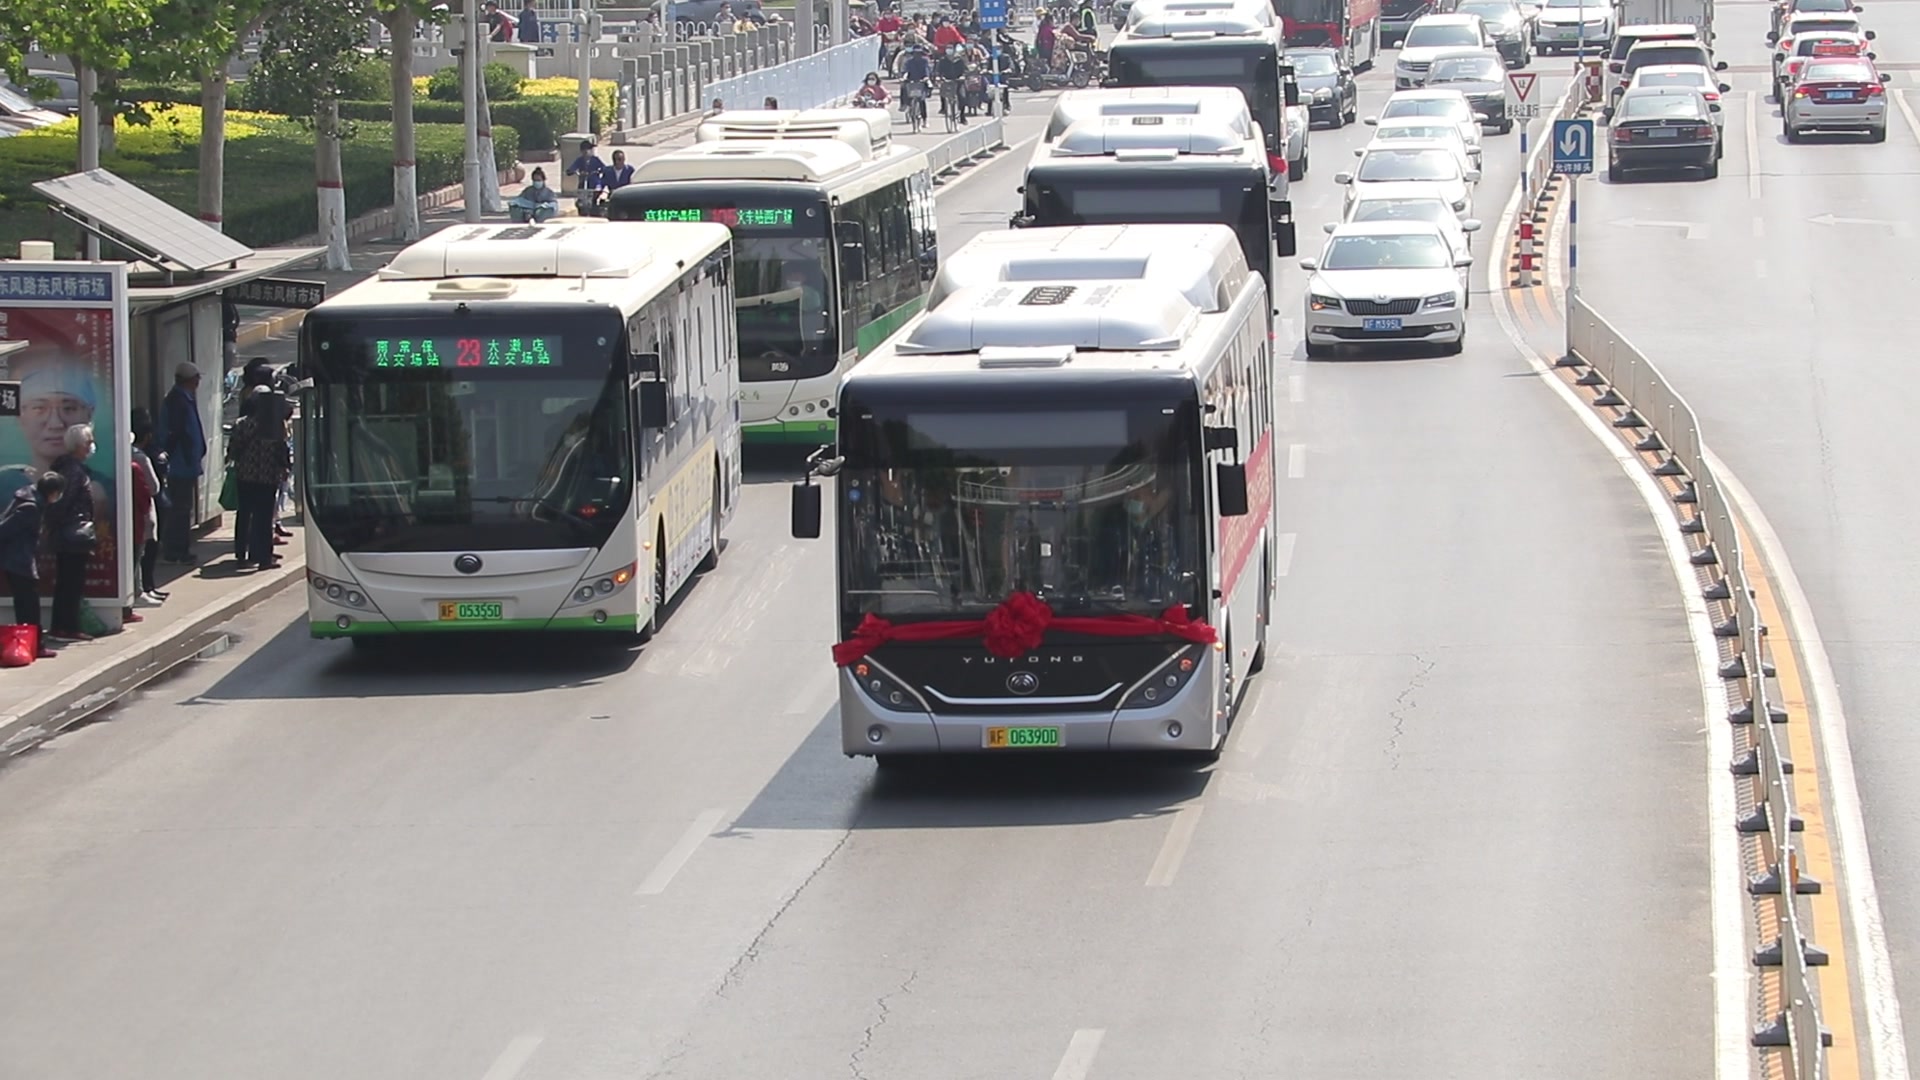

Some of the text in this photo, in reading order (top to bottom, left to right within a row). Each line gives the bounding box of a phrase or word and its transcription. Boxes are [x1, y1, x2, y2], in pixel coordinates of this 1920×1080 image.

[1555, 163, 1591, 172] 允许掉头
[736, 209, 793, 225] 火车站西广场
[0, 276, 105, 296] 东风路东风桥市场
[376, 352, 439, 367] 公交场站
[457, 339, 481, 366] 23
[488, 352, 550, 366] 公交场站
[1010, 729, 1058, 744] 06390D
